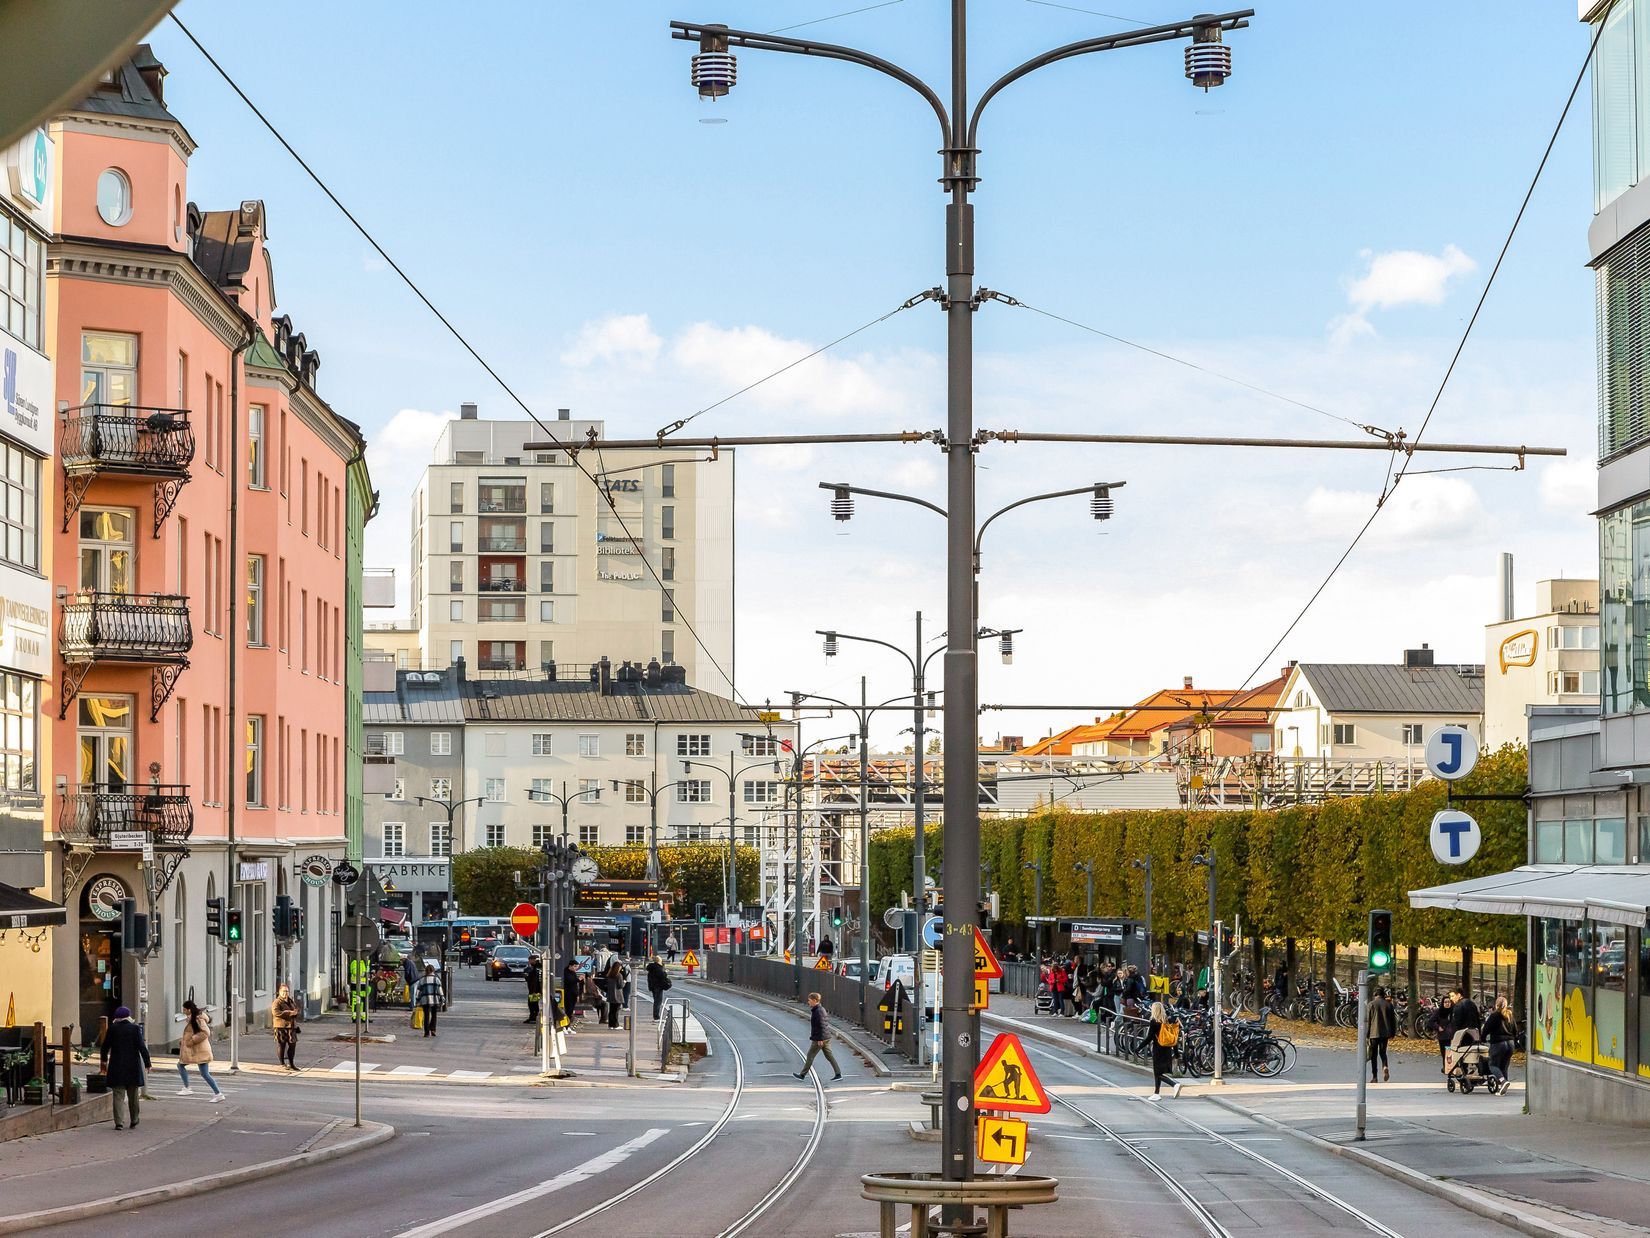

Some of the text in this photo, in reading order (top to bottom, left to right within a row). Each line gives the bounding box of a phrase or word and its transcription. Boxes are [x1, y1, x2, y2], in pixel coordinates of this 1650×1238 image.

[602, 479, 641, 492] SATS
[597, 546, 635, 555] Bibliotek
[600, 572, 612, 580] The
[1436, 733, 1462, 774] J
[1440, 820, 1471, 858] T
[303, 856, 330, 869] ESPRESSO
[306, 876, 328, 886] HOUSE
[92, 880, 124, 897] ESPRESSO
[946, 923, 973, 936] 3-43
